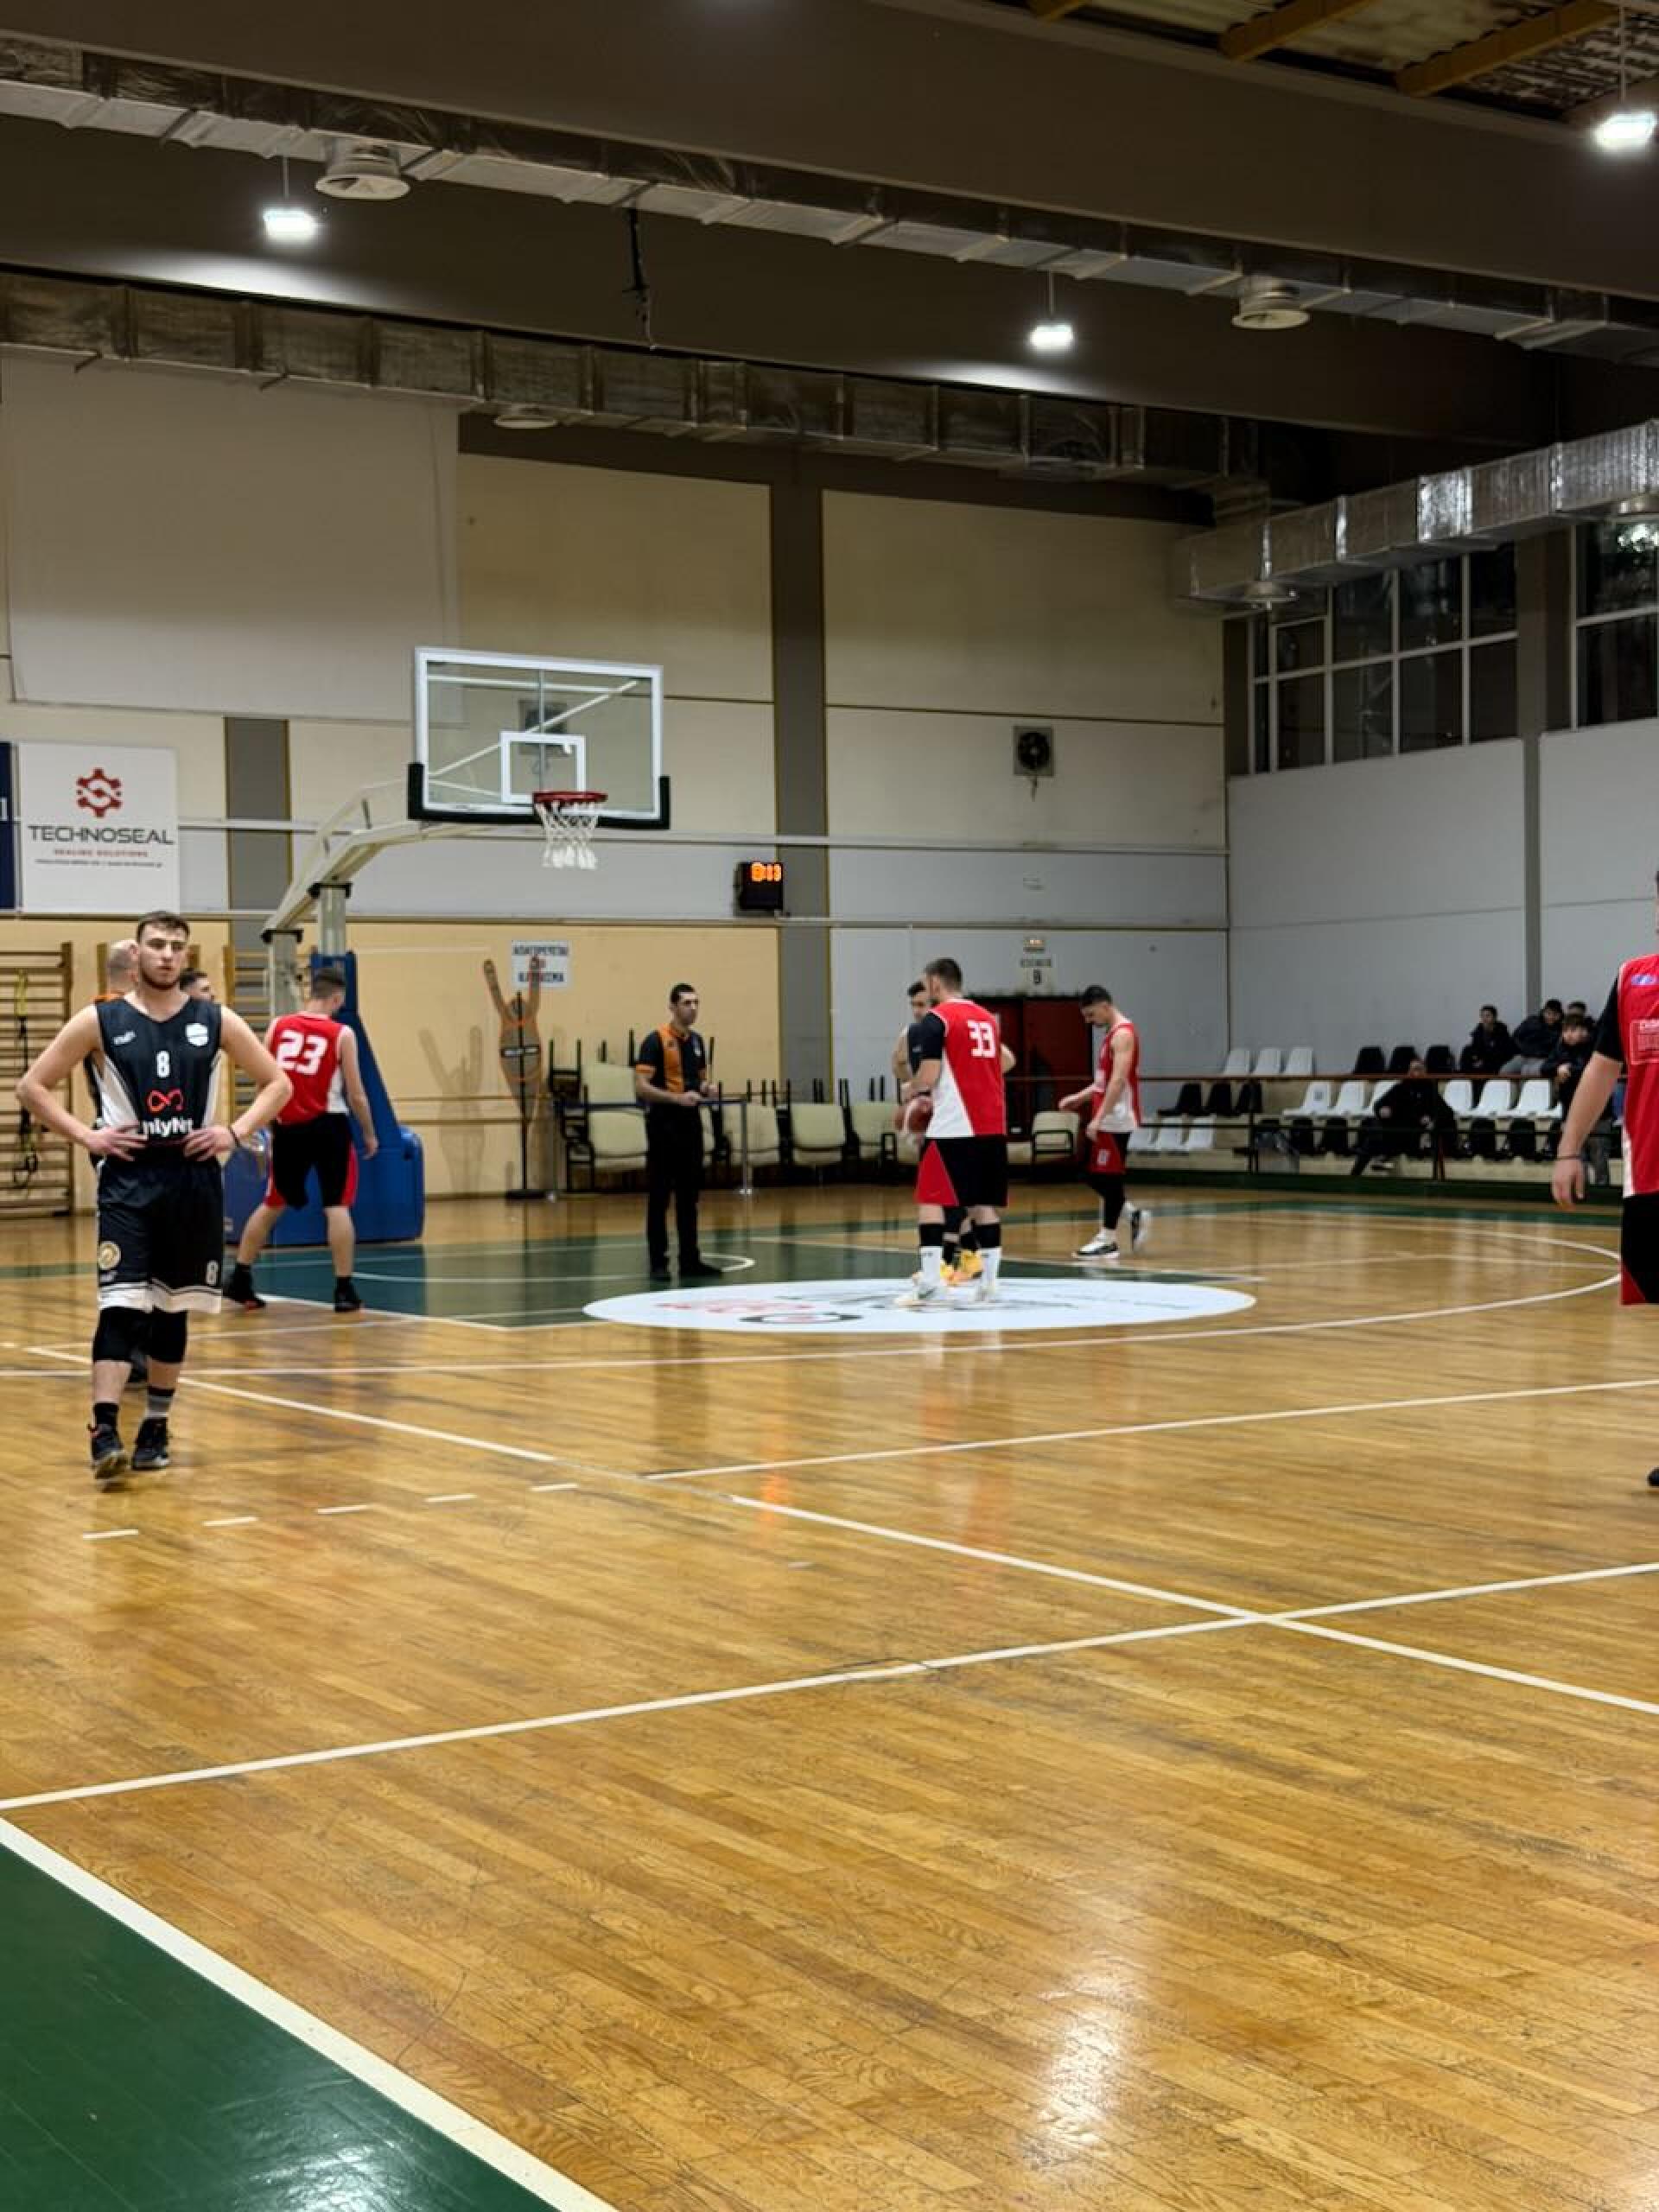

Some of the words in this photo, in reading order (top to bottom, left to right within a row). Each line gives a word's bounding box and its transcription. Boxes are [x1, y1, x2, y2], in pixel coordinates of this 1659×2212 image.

[28, 825, 175, 845] TECHNOSEAL
[967, 1019, 996, 1058] 33
[156, 1050, 170, 1077] 8
[276, 1029, 327, 1076] 23
[206, 1260, 219, 1286] 8
